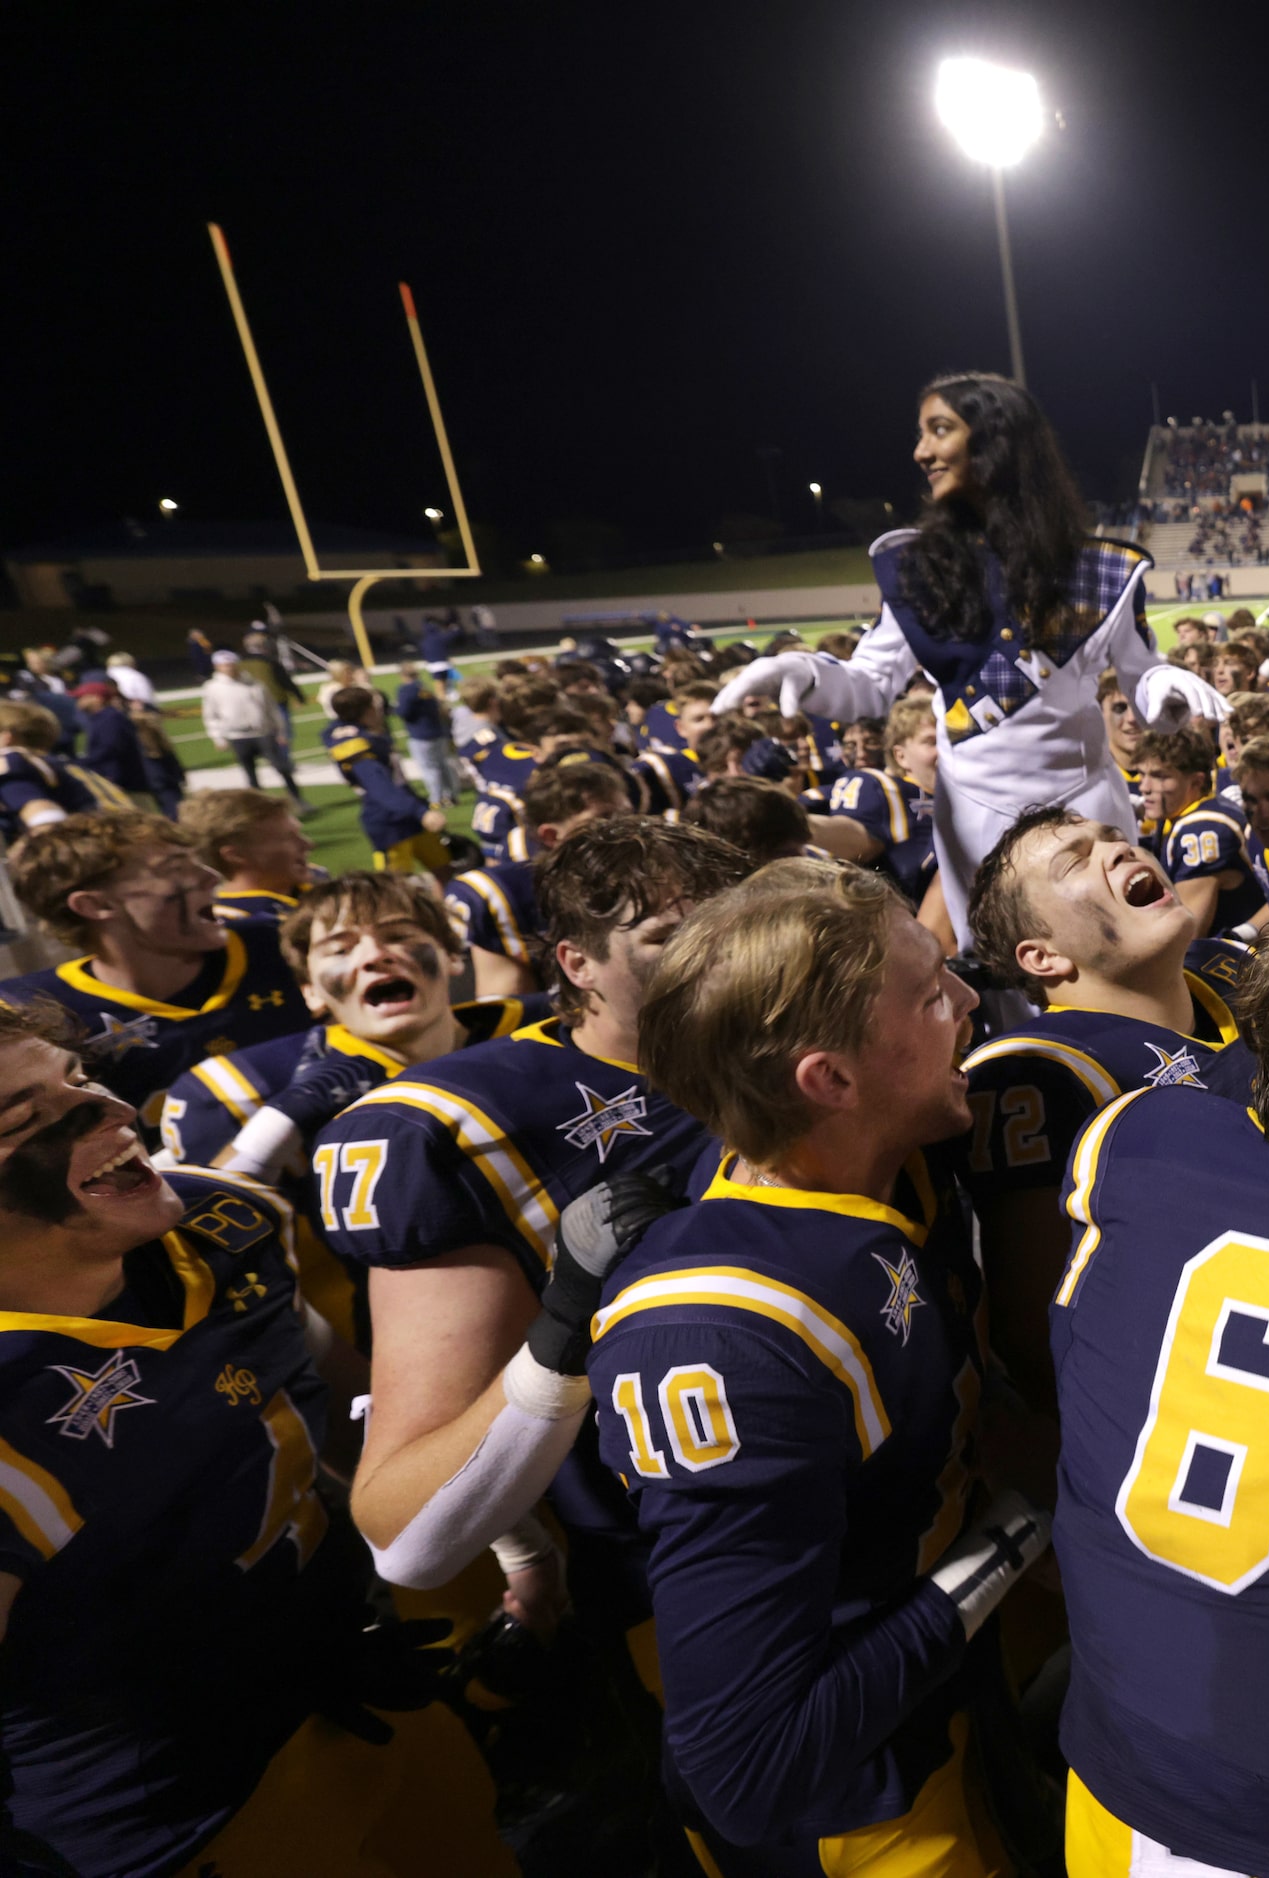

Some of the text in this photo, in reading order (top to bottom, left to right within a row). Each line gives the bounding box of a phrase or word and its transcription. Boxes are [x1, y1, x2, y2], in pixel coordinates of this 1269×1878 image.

[1180, 830, 1221, 867] 38
[966, 1083, 1052, 1173] 72
[312, 1138, 390, 1232] 17
[611, 1362, 742, 1480] 10
